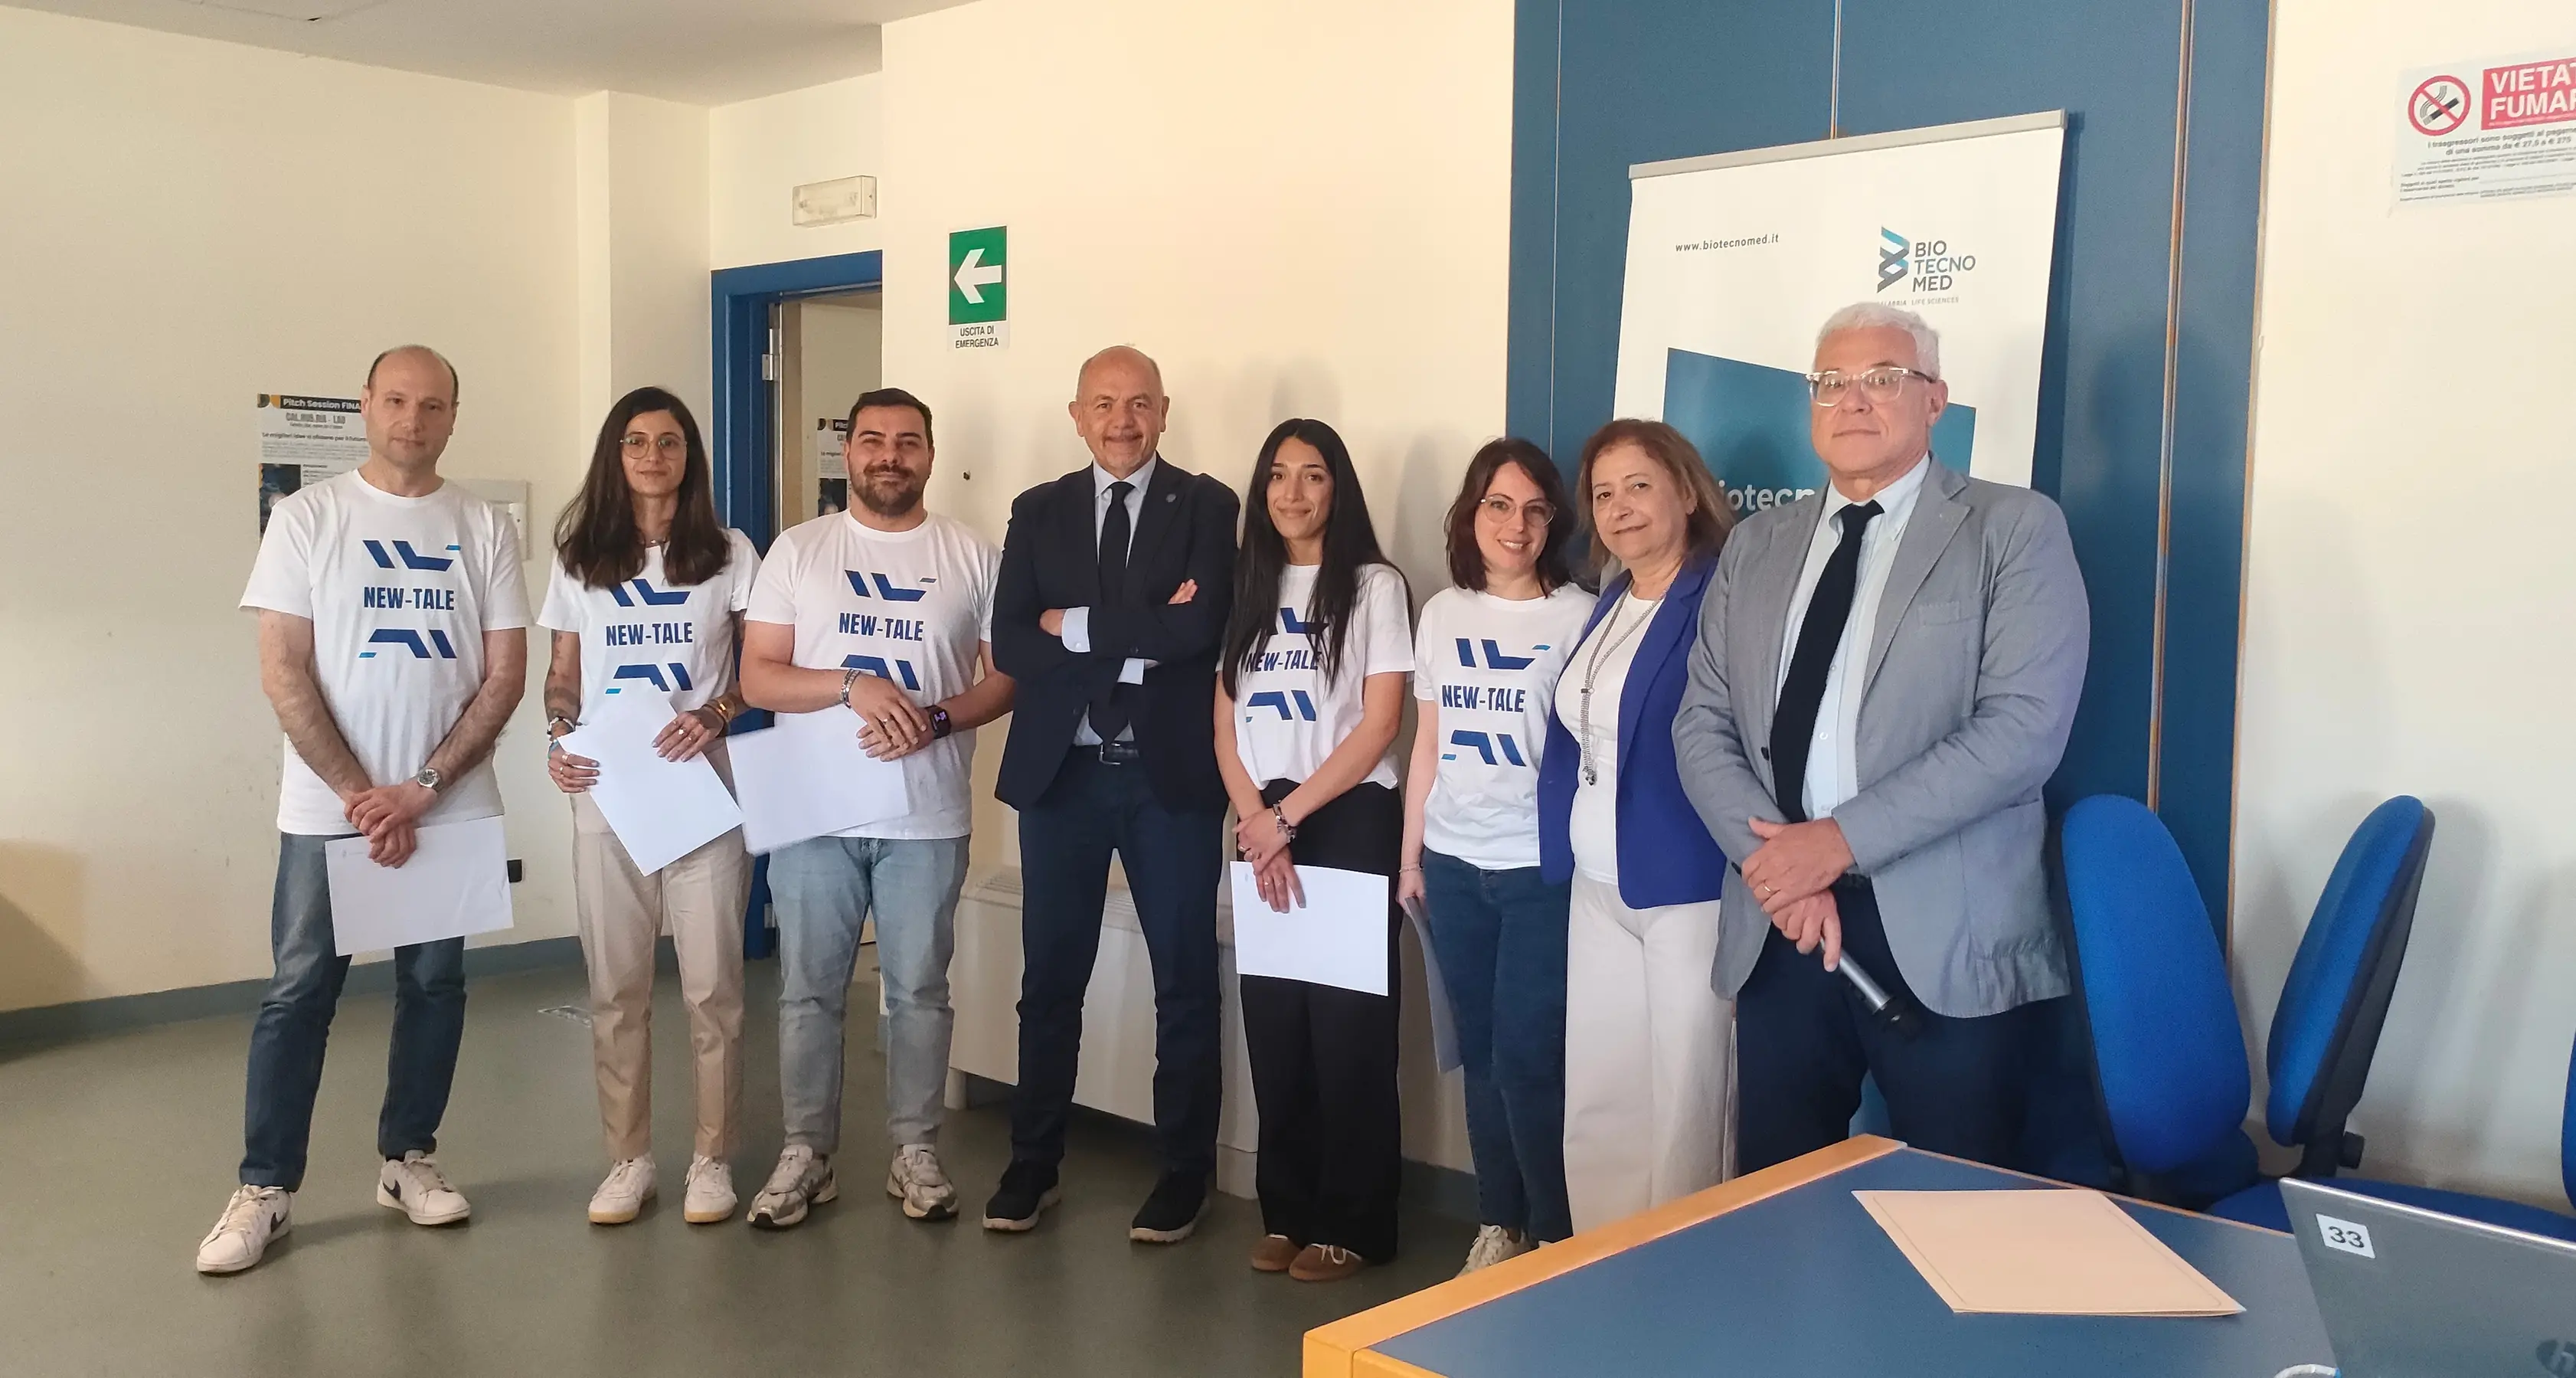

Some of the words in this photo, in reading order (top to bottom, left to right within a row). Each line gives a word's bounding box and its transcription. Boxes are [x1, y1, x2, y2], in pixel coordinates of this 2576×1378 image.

[2432, 138, 2478, 147] trasgressori
[1675, 233, 1779, 252] www.biotecnomed.it
[1915, 240, 1947, 257] BIO
[1914, 255, 1976, 275] TECNO
[1912, 275, 1953, 292] MED
[960, 326, 985, 336] USCITA
[987, 326, 994, 335] DI
[956, 337, 999, 349] EMERGENZA
[283, 398, 306, 408] Pitch
[307, 400, 340, 409] Session
[364, 586, 454, 610] NEW-TALE
[606, 622, 693, 646] NEW-TALE
[839, 612, 924, 642] NEW-TALE
[1442, 685, 1525, 713] NEW-TALE
[2329, 1226, 2365, 1249] 33
